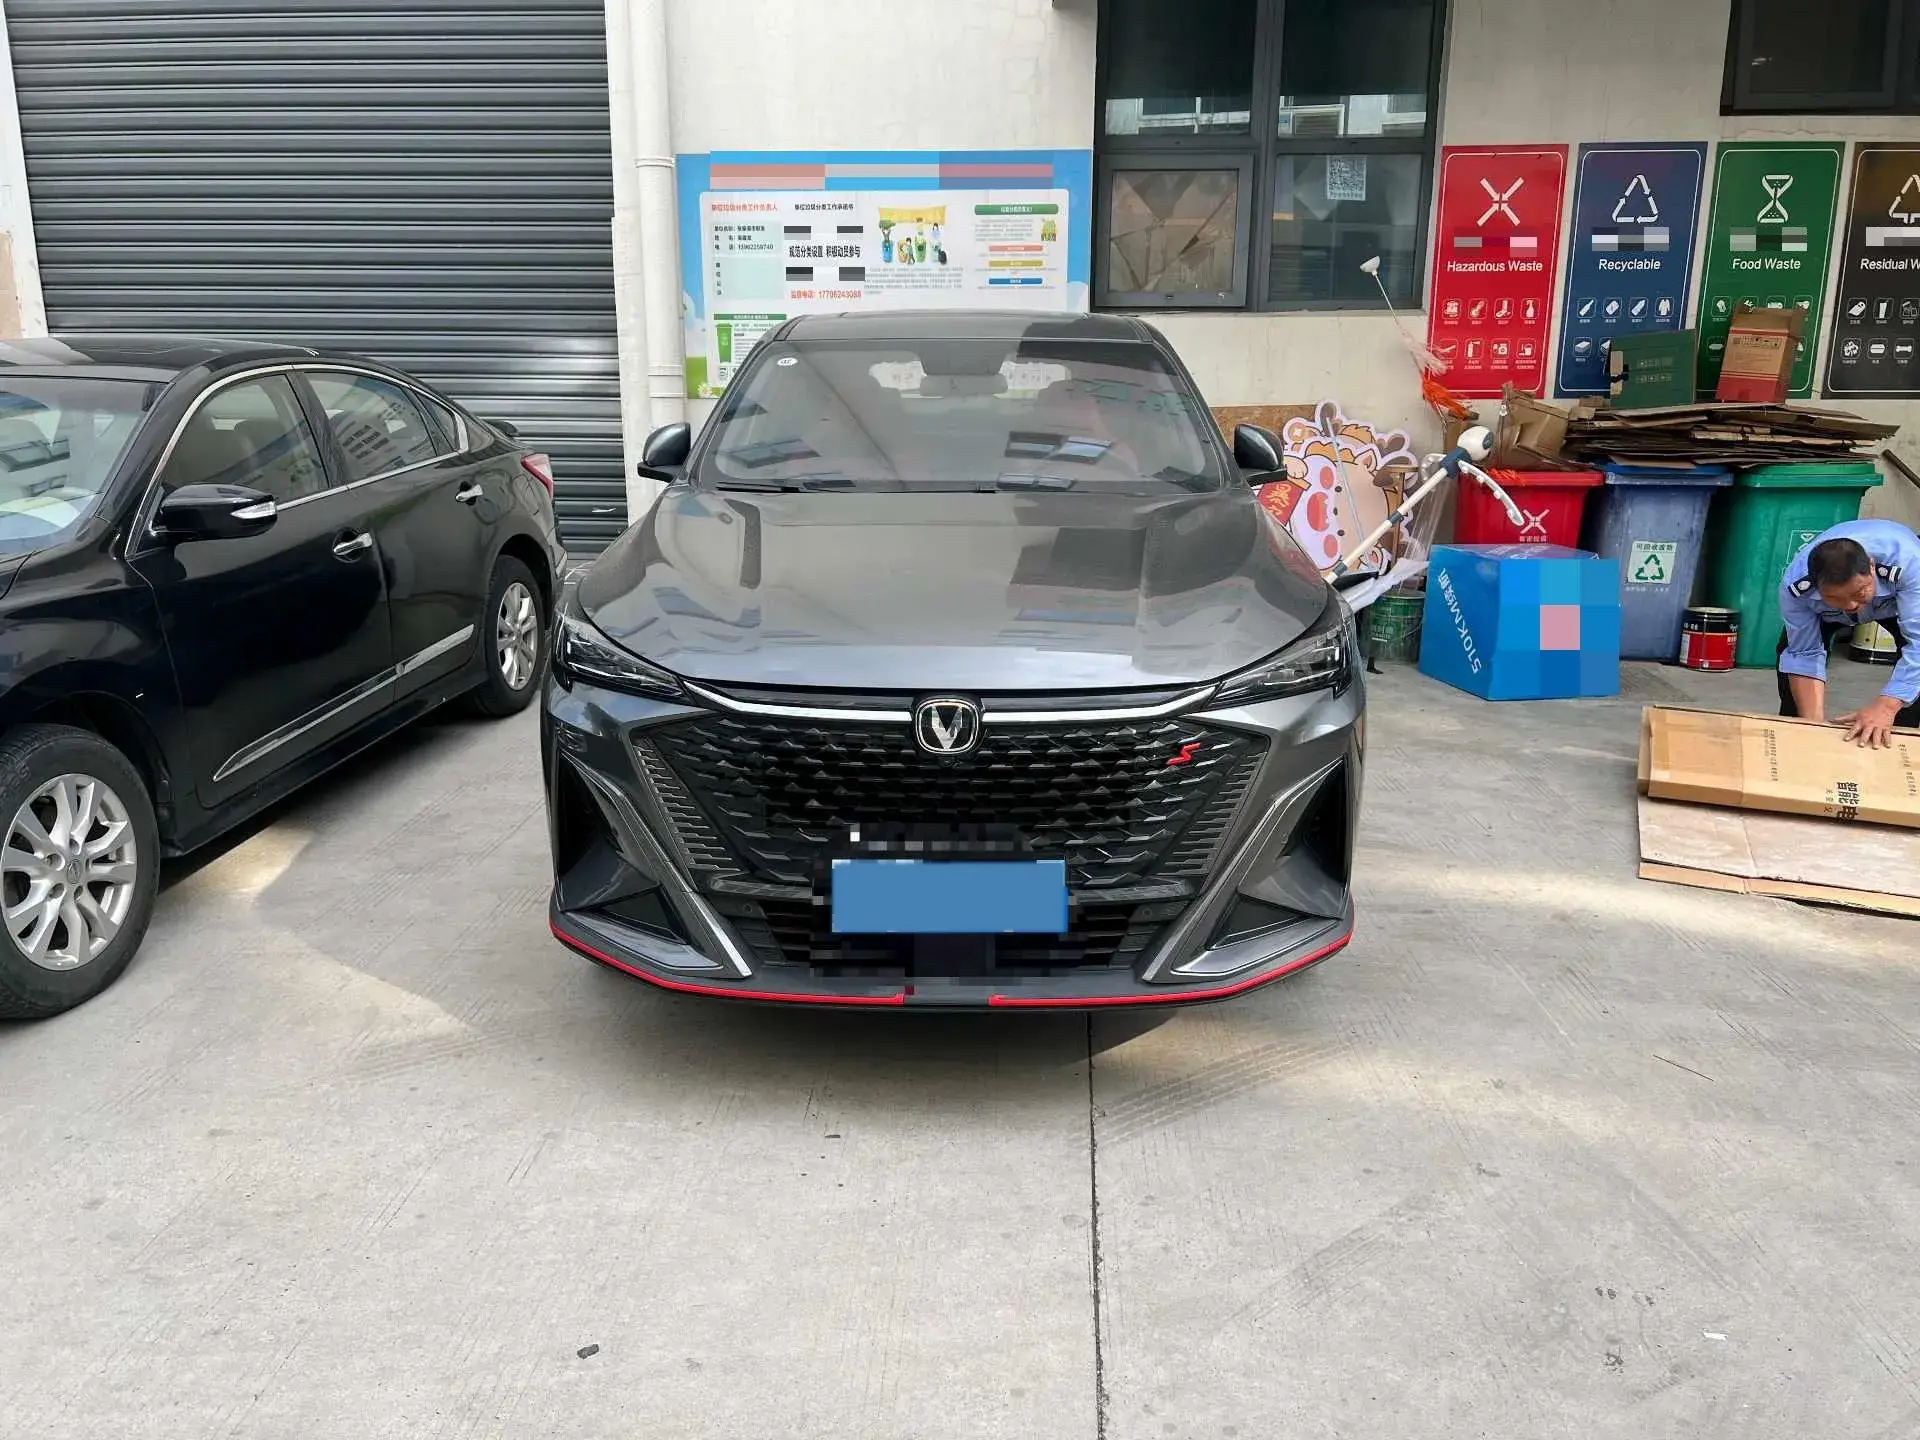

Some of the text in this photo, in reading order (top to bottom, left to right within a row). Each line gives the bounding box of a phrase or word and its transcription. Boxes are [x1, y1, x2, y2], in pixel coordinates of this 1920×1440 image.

[1446, 260, 1543, 272] Hazardous Waste
[1598, 258, 1661, 271] Recyclable
[1732, 258, 1801, 270] Food Waste
[1860, 258, 1909, 270] Residual
